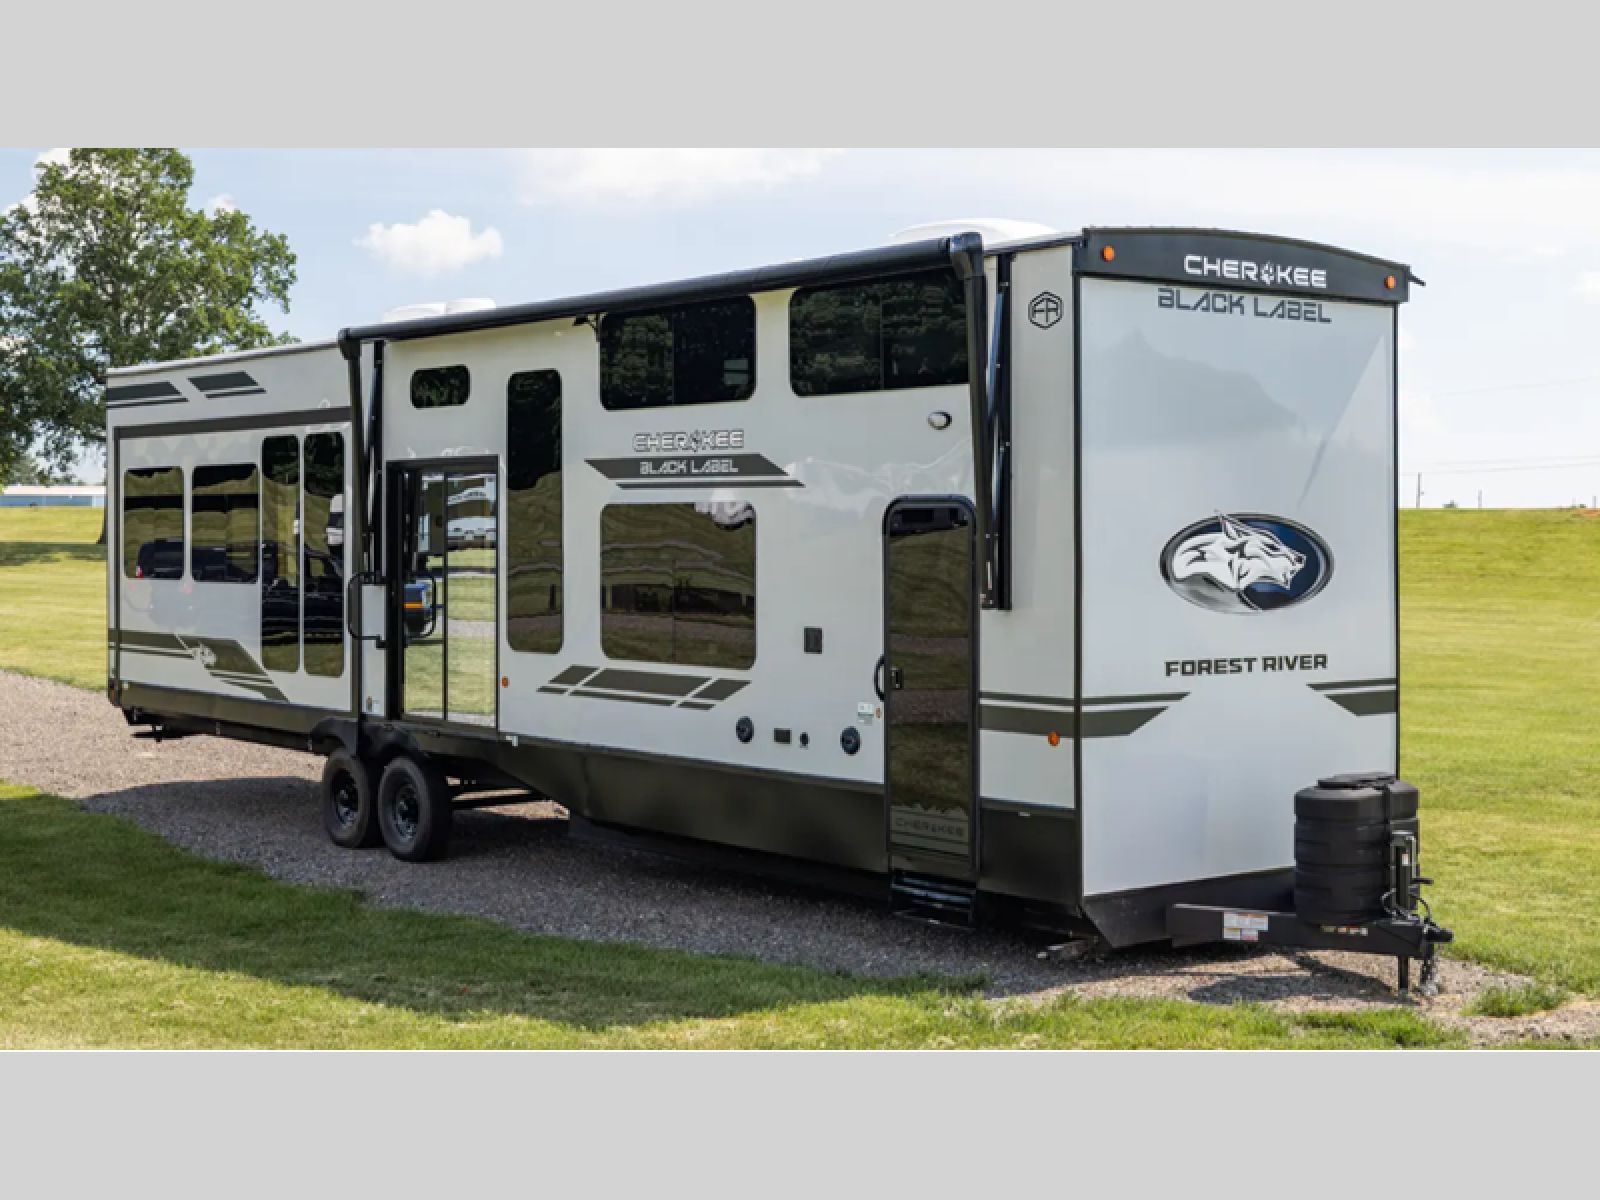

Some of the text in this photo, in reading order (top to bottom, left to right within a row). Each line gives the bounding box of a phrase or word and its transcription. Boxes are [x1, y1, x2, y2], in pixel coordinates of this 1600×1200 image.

[1184, 254, 1327, 289] CHEROKEE
[1158, 287, 1332, 324] BLACK LABEL
[633, 429, 744, 452] CHEROKEE
[640, 458, 739, 475] BLACK LABEL
[1164, 653, 1328, 677] FOREST RIVER
